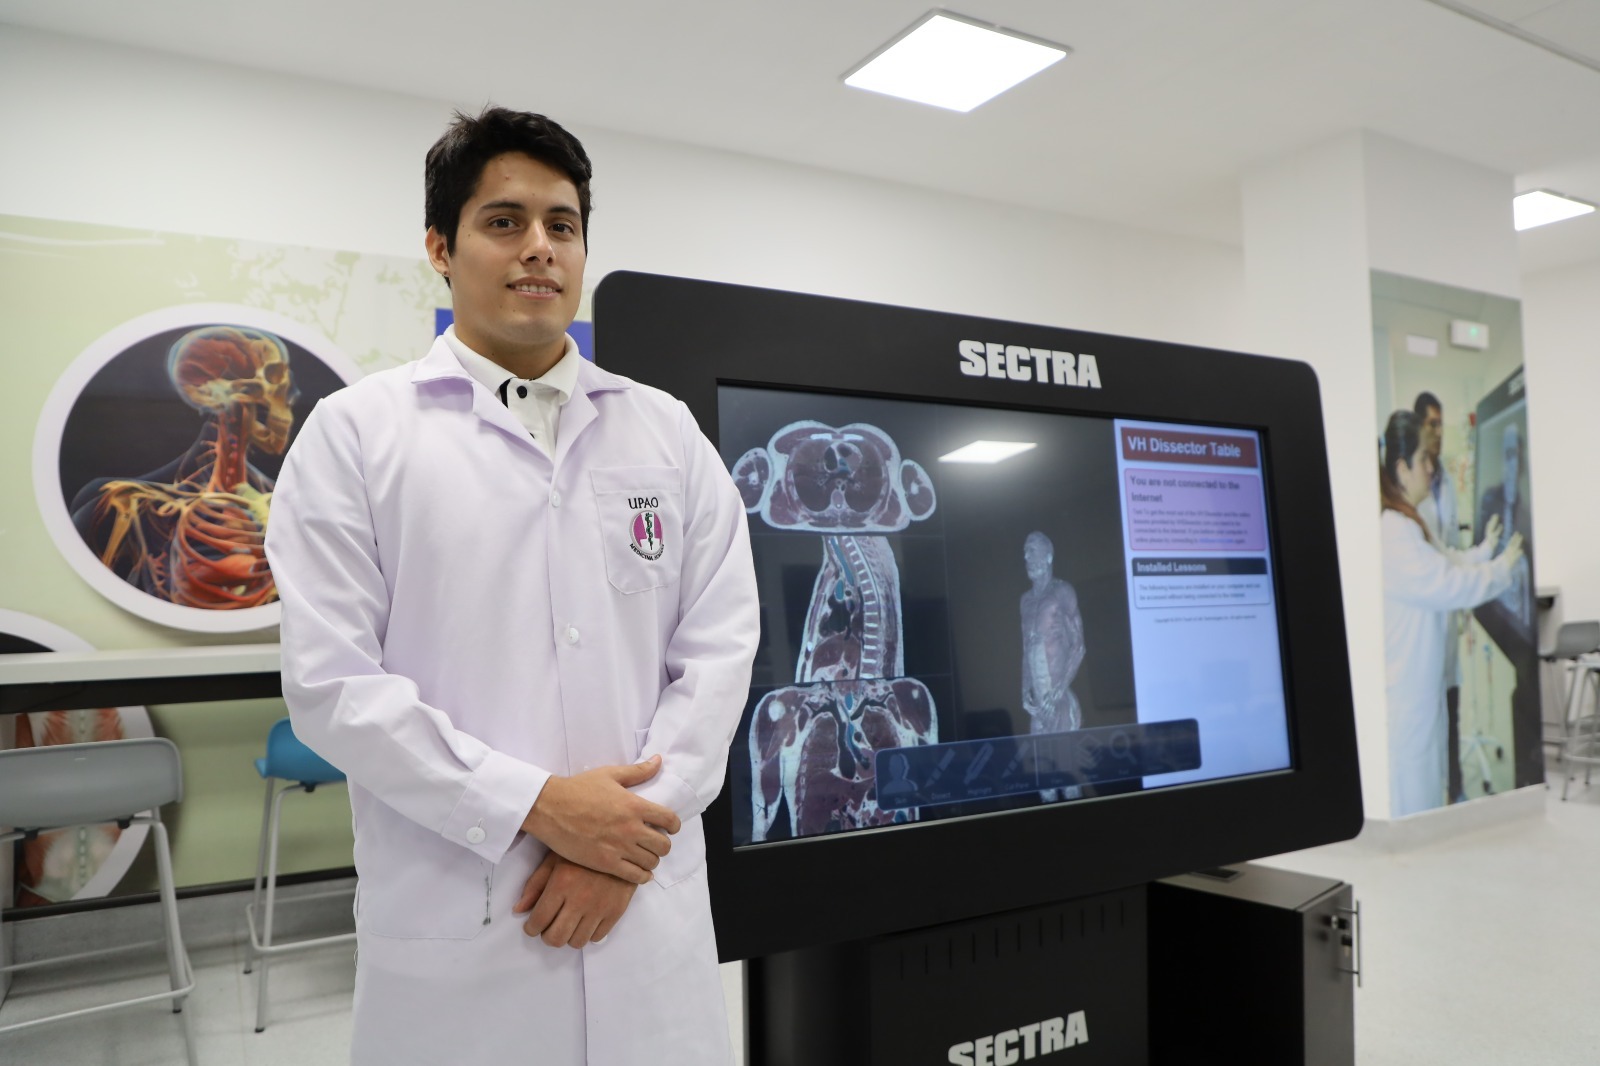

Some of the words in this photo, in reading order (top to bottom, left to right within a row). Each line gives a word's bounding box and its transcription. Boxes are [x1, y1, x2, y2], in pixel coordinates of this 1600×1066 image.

[959, 339, 1102, 389] SECTRA
[1127, 435, 1147, 451] VH
[1150, 437, 1207, 455] Dissector
[1210, 441, 1241, 458] Table
[1130, 475, 1147, 487] You
[1148, 478, 1160, 487] are
[1163, 477, 1177, 487] not
[1178, 478, 1217, 489] connected
[628, 497, 659, 510] UPAO
[1131, 492, 1163, 503] Internet
[1137, 561, 1173, 573] Installed
[1173, 561, 1207, 572] Lessons
[947, 1009, 1089, 1066] SECTRA
